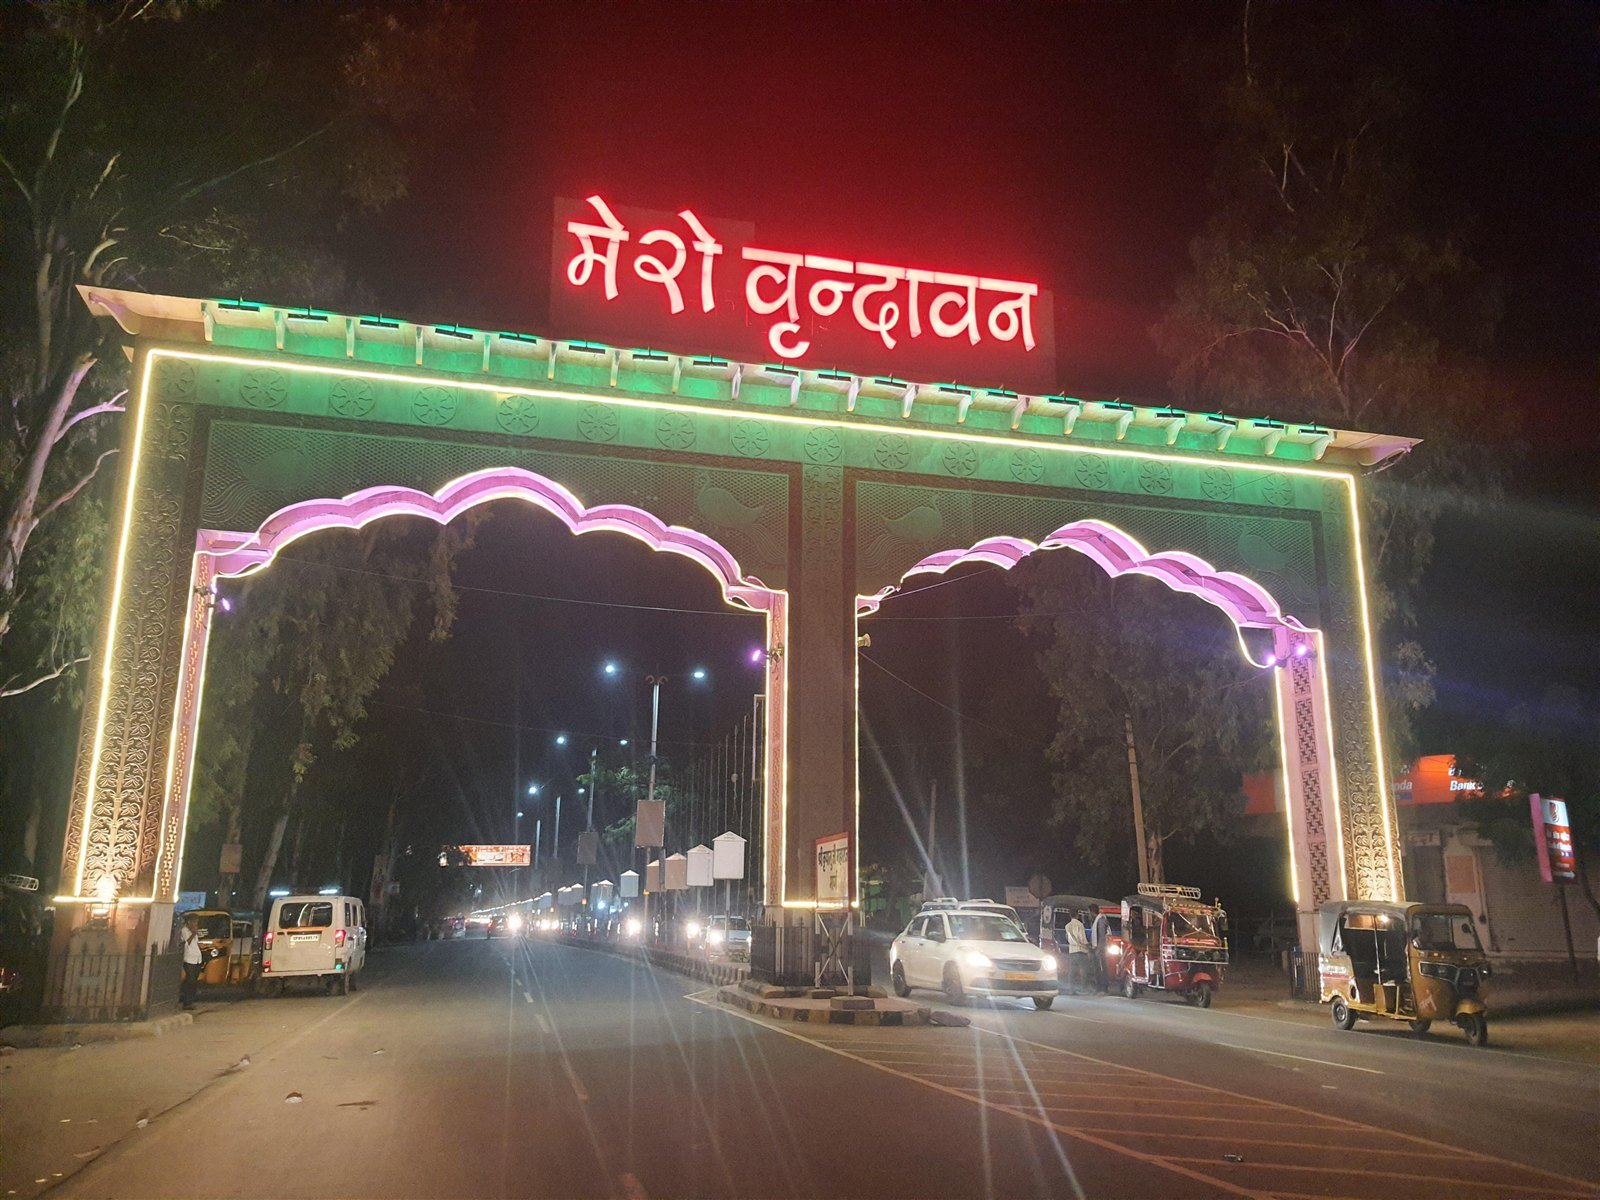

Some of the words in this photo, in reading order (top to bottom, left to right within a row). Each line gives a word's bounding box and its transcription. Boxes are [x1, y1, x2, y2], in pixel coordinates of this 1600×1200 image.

[567, 195, 723, 314] मेरो
[742, 246, 1038, 358] वृन्दावन
[1450, 780, 1476, 791] Bank
